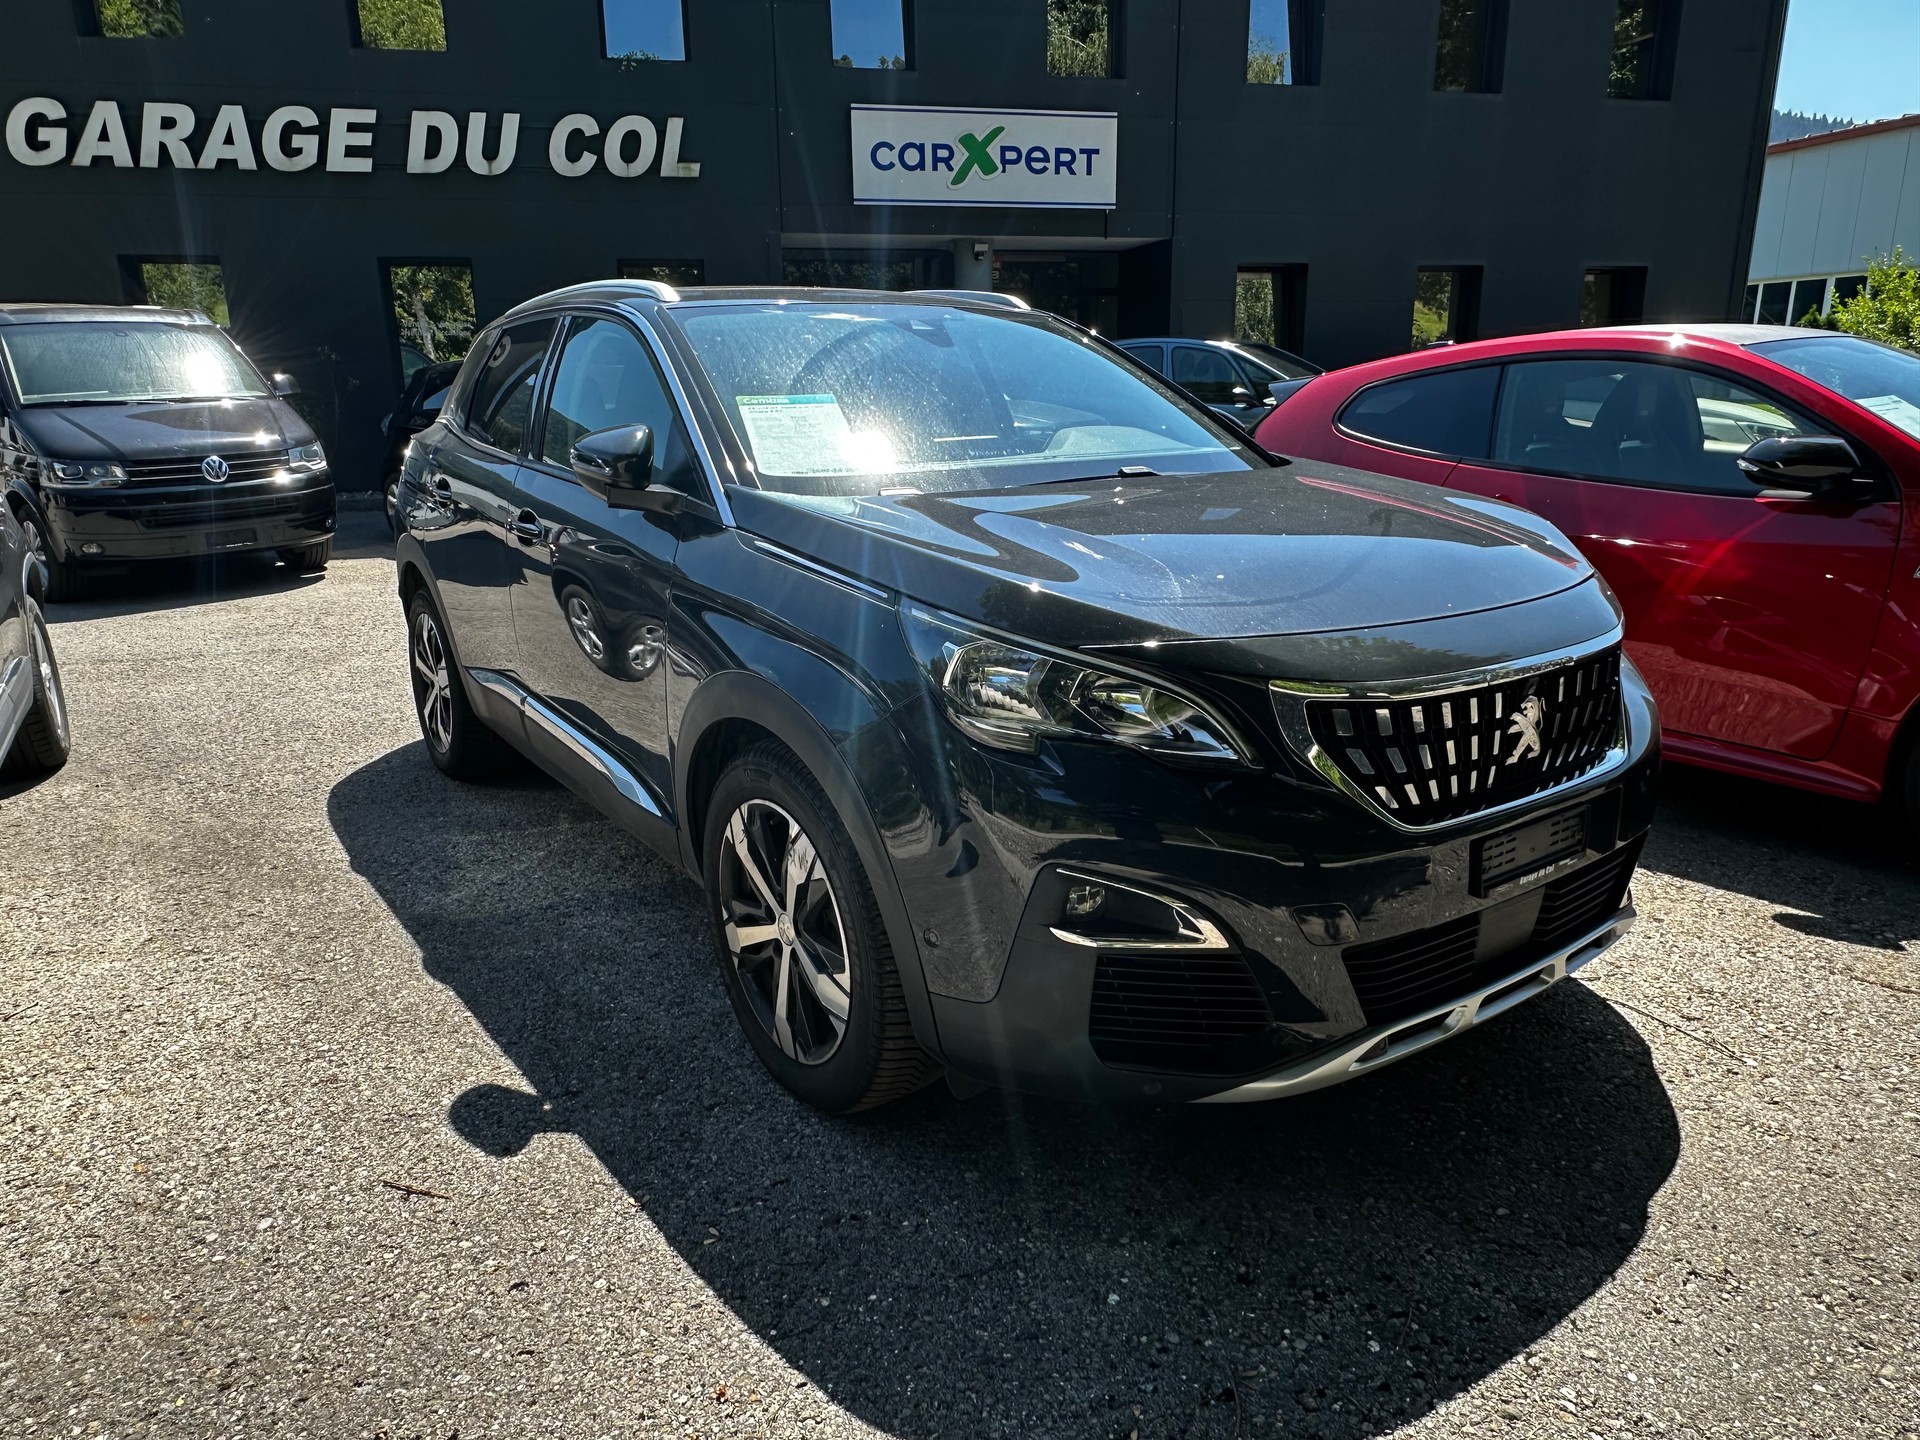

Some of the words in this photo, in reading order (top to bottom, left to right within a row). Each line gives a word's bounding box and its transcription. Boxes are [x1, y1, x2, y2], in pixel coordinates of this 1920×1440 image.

[6, 97, 377, 171] GARAGE
[406, 110, 520, 175] DU
[548, 113, 701, 178] COL
